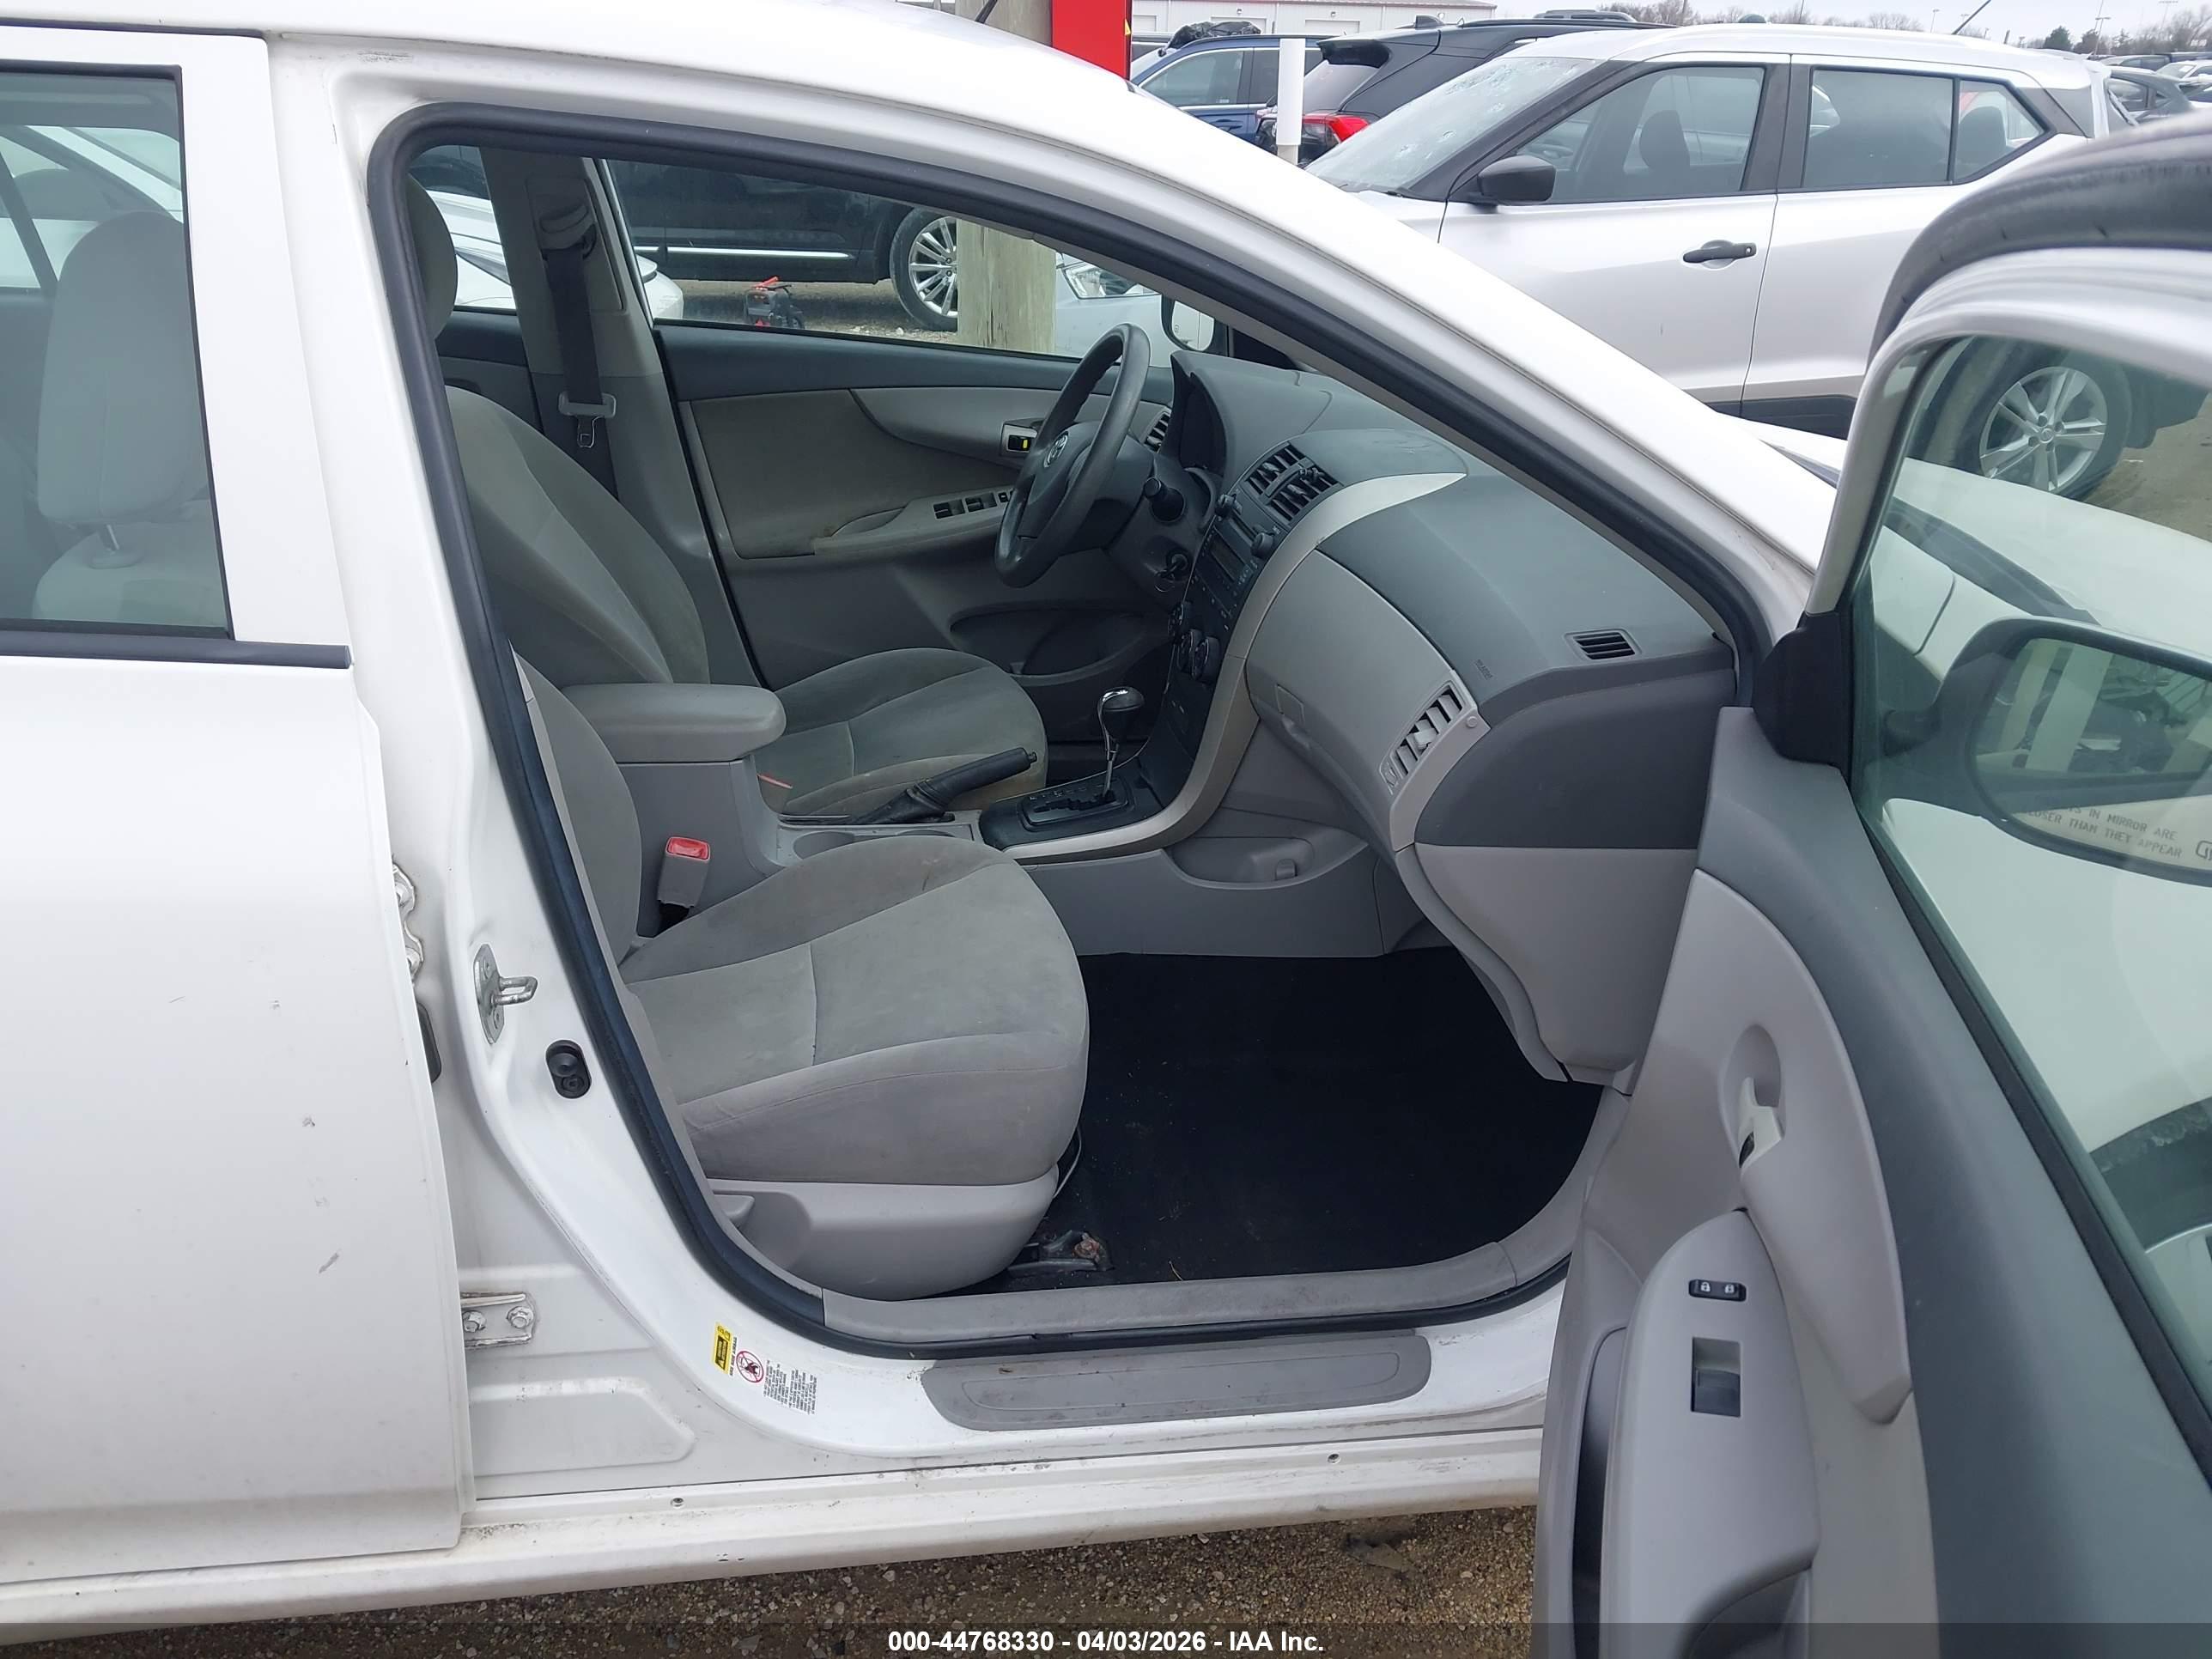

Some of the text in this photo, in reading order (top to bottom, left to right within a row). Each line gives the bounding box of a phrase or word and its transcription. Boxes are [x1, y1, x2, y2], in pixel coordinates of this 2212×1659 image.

[2069, 817, 2098, 834] THAN
[2104, 827, 2133, 844] THEY
[2137, 837, 2182, 859] APPEAR
[2106, 813, 2148, 832] MIRROR
[2153, 827, 2179, 841] ARE
